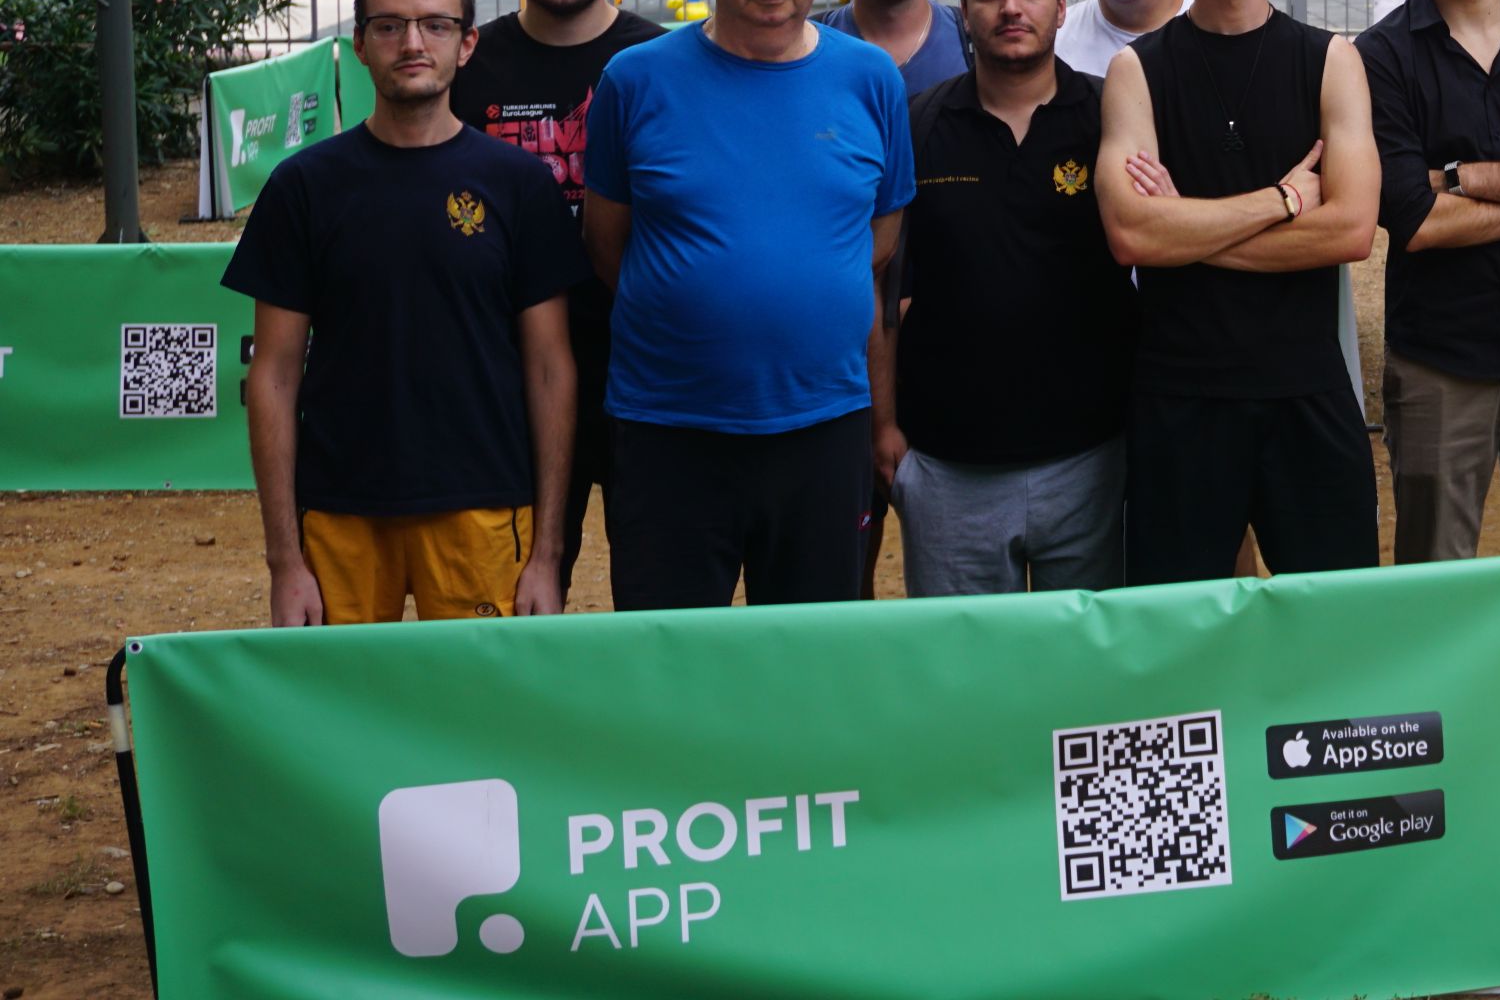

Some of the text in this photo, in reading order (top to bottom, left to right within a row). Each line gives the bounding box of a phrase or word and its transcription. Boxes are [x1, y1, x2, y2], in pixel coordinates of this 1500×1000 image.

[246, 113, 277, 138] PROFIT
[1322, 721, 1420, 740] Available on the
[1323, 739, 1428, 769] App Store
[1329, 813, 1434, 843] Google play
[1330, 809, 1368, 820] Get it on
[567, 790, 860, 875] PROFIT
[570, 882, 721, 952] APP
